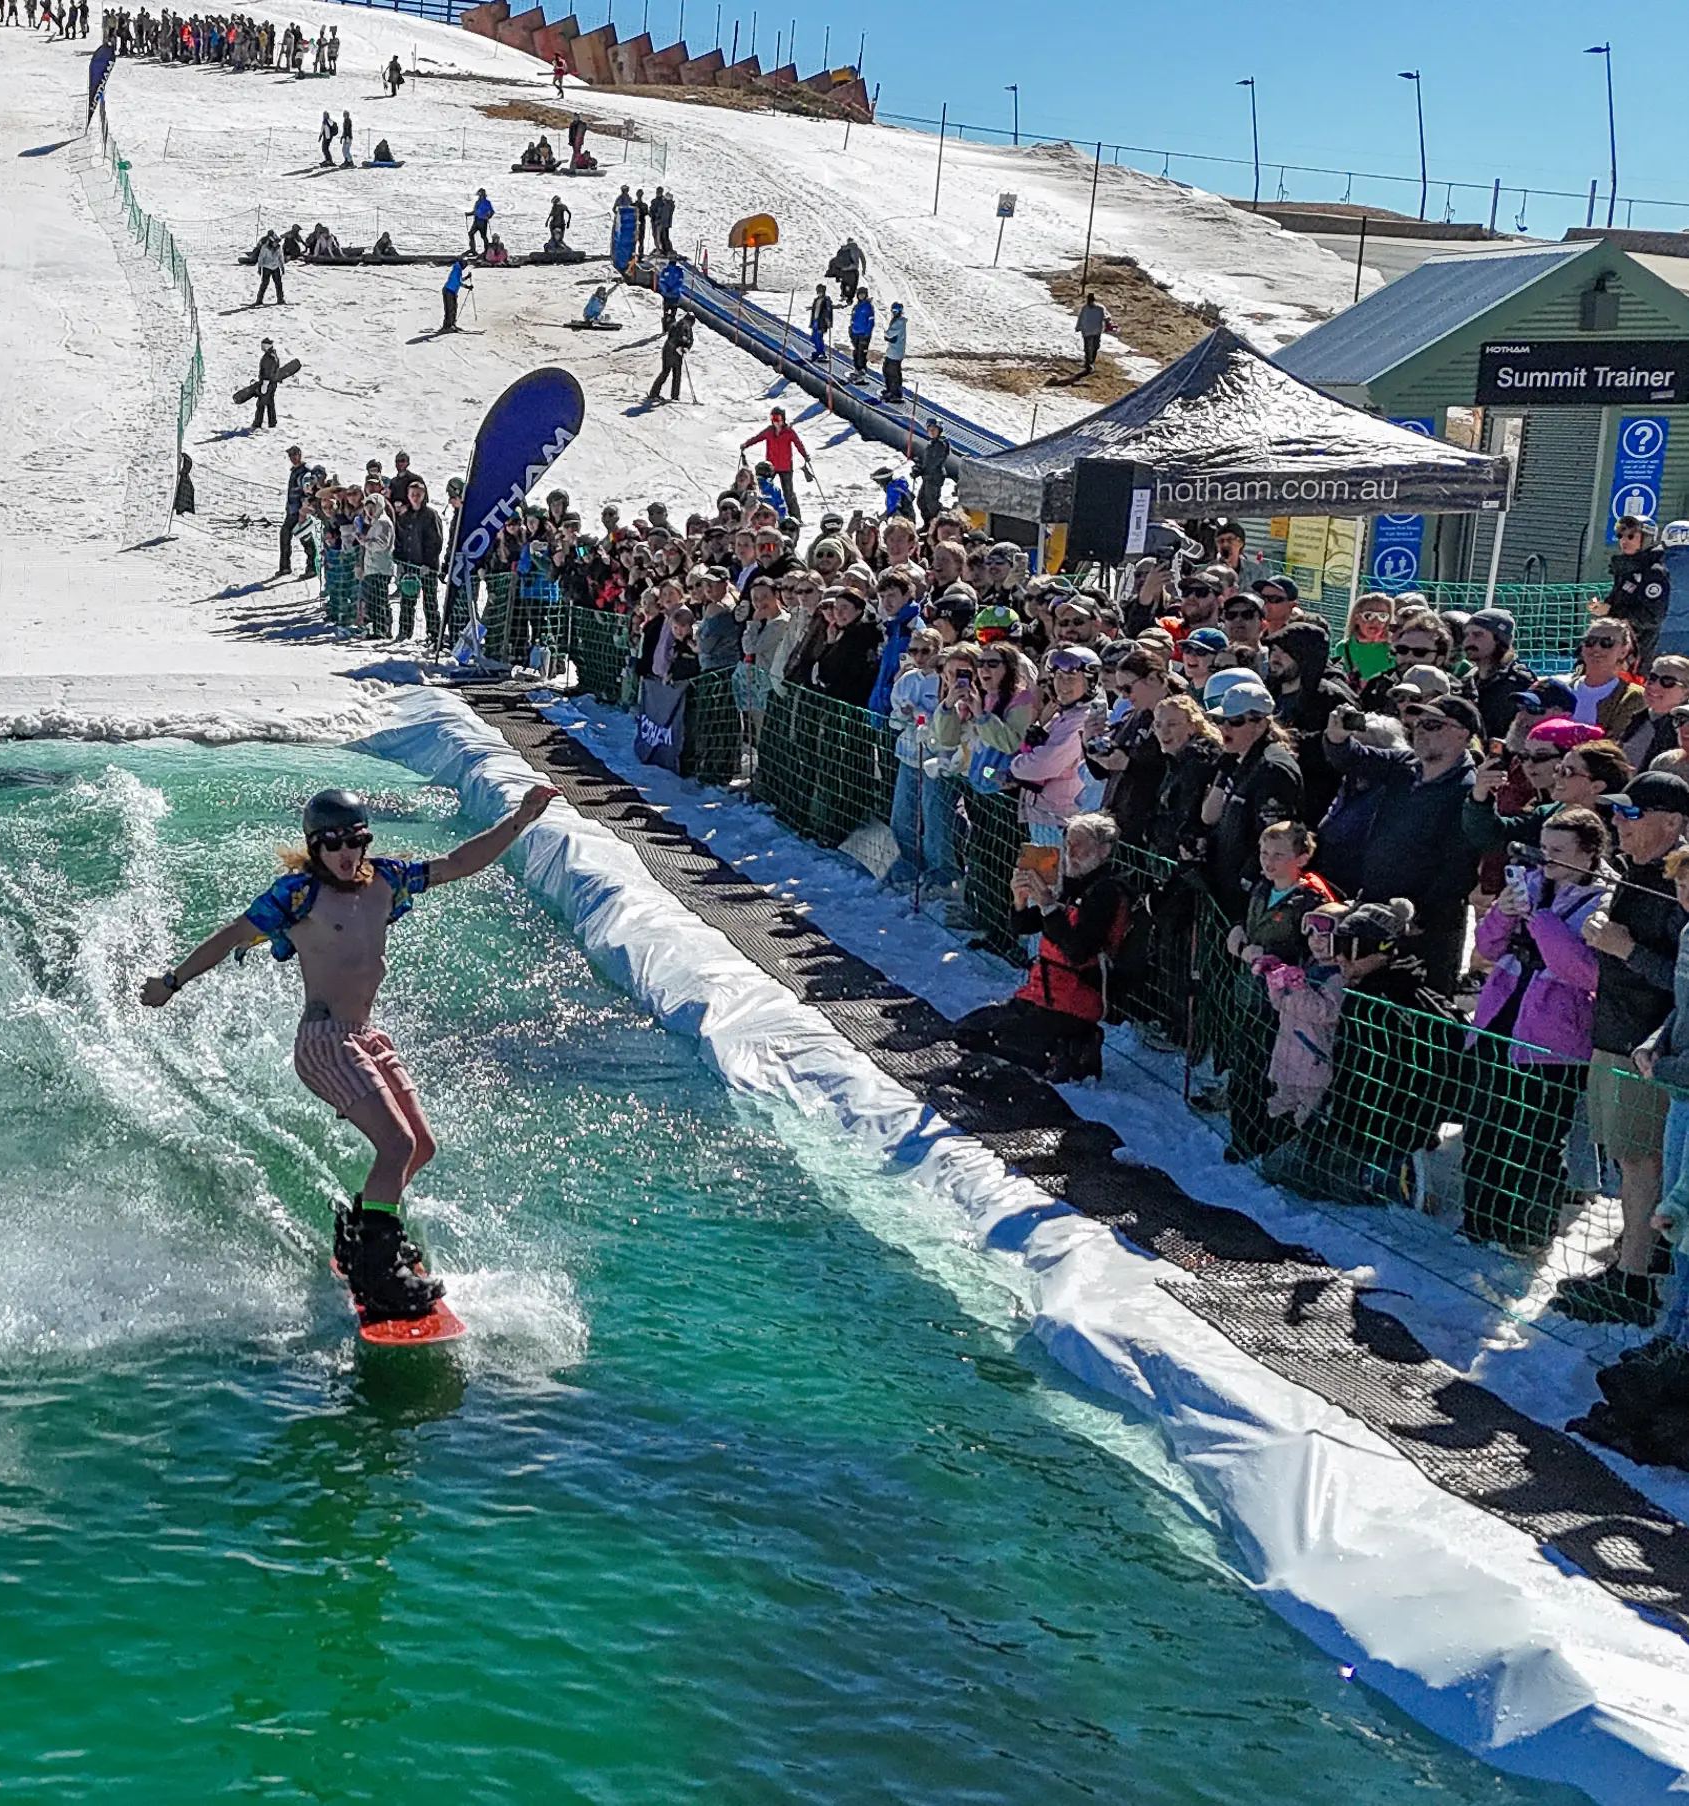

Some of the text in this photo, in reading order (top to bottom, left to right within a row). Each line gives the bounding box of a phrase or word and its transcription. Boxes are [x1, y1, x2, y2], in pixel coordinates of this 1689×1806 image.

[1485, 346, 1531, 354] HOTHAM
[1496, 365, 1676, 388] Summit Trainer
[1155, 476, 1399, 503] hotham.com.au
[451, 426, 576, 588] HOTHAM
